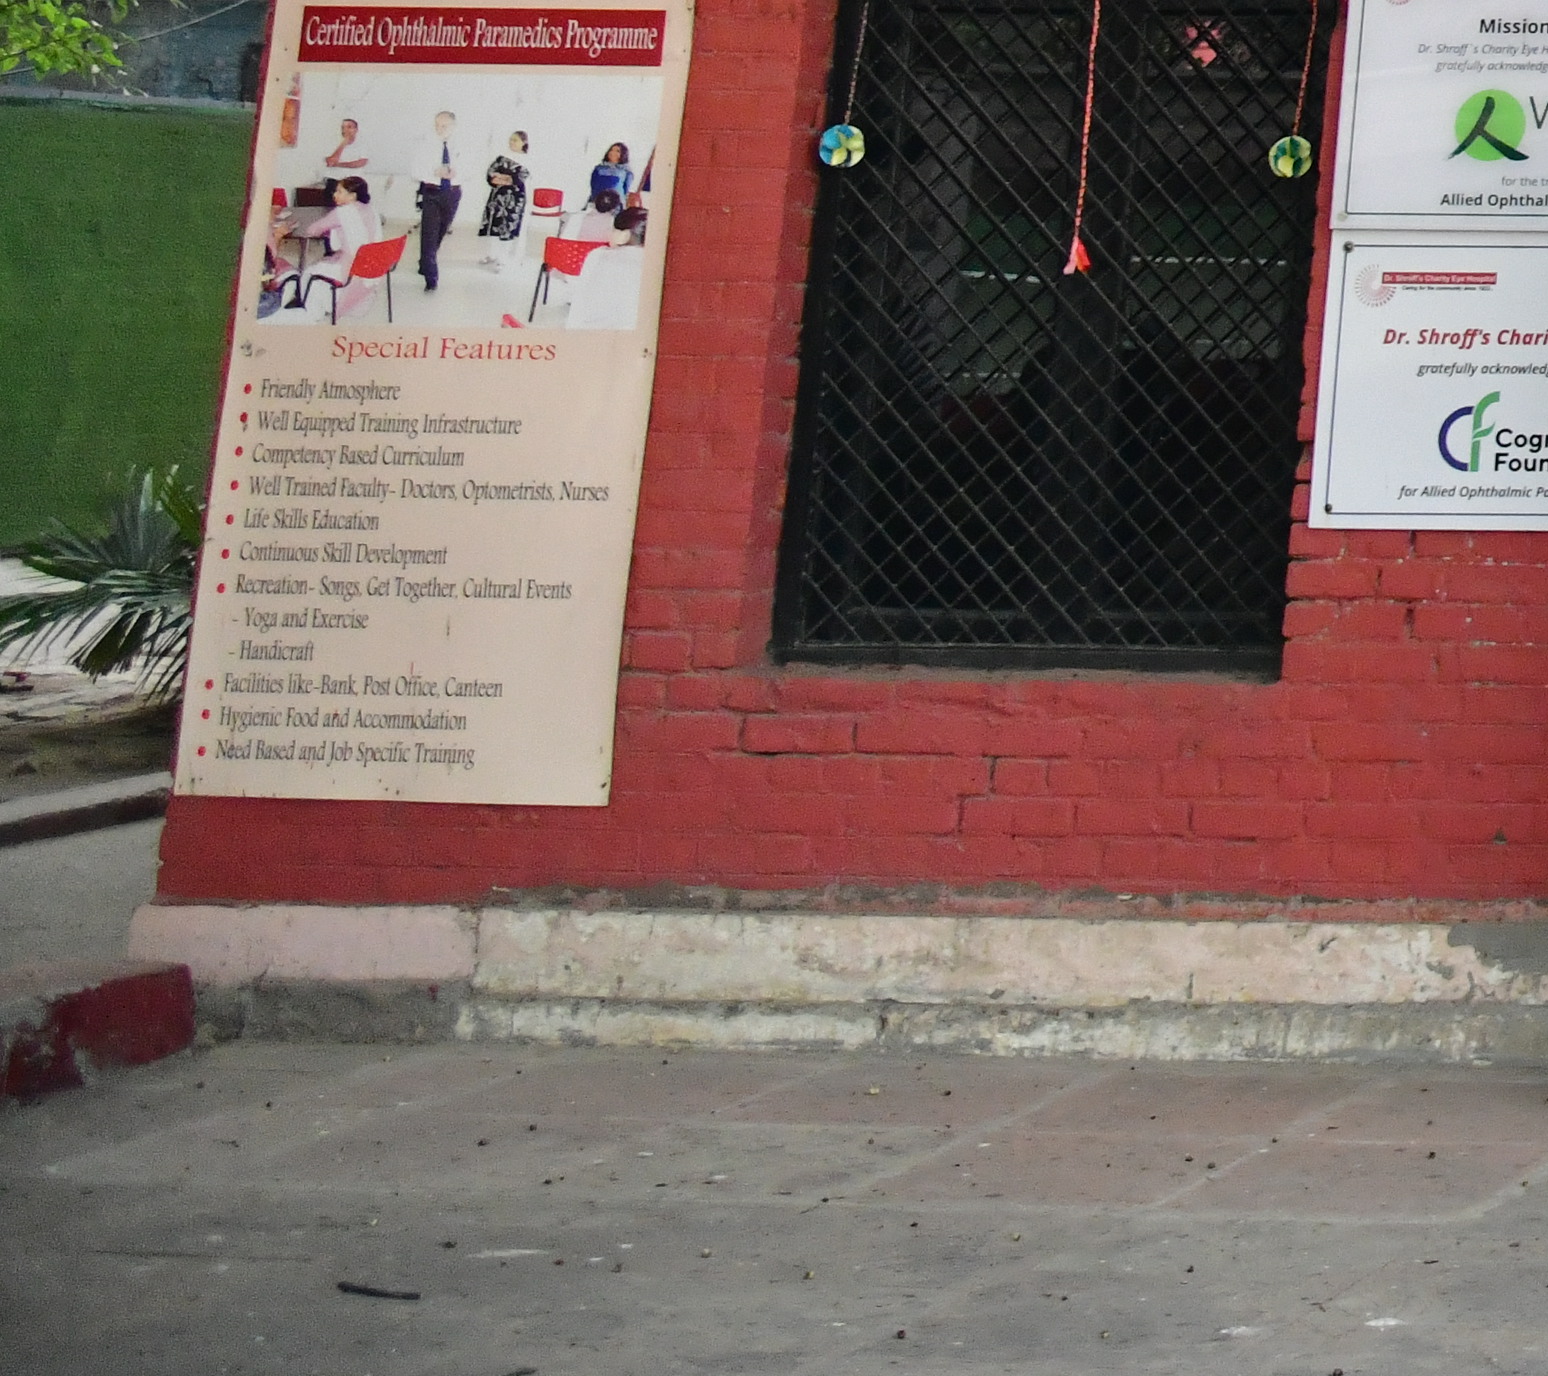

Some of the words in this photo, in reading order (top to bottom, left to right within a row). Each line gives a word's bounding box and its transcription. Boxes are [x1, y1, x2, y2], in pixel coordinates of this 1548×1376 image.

[306, 15, 375, 46] Certified
[377, 16, 470, 54] Ophthalmic
[473, 18, 563, 48] Paramedics
[565, 20, 657, 58] Programme
[1440, 194, 1483, 206] Allied
[332, 336, 428, 364] Special
[440, 338, 555, 360] Features
[1383, 329, 1409, 344] Dr.
[1418, 329, 1490, 349] Shroff's
[1417, 362, 1478, 377] gratefully
[261, 378, 313, 398] Friendly
[318, 380, 400, 405] Atmosphere
[258, 410, 289, 431] Well
[293, 411, 356, 437] Equipped
[360, 413, 418, 439] Training
[423, 413, 522, 434] Infrastructure
[244, 508, 270, 528] Life
[272, 508, 308, 529] Skills
[312, 509, 379, 530] Education
